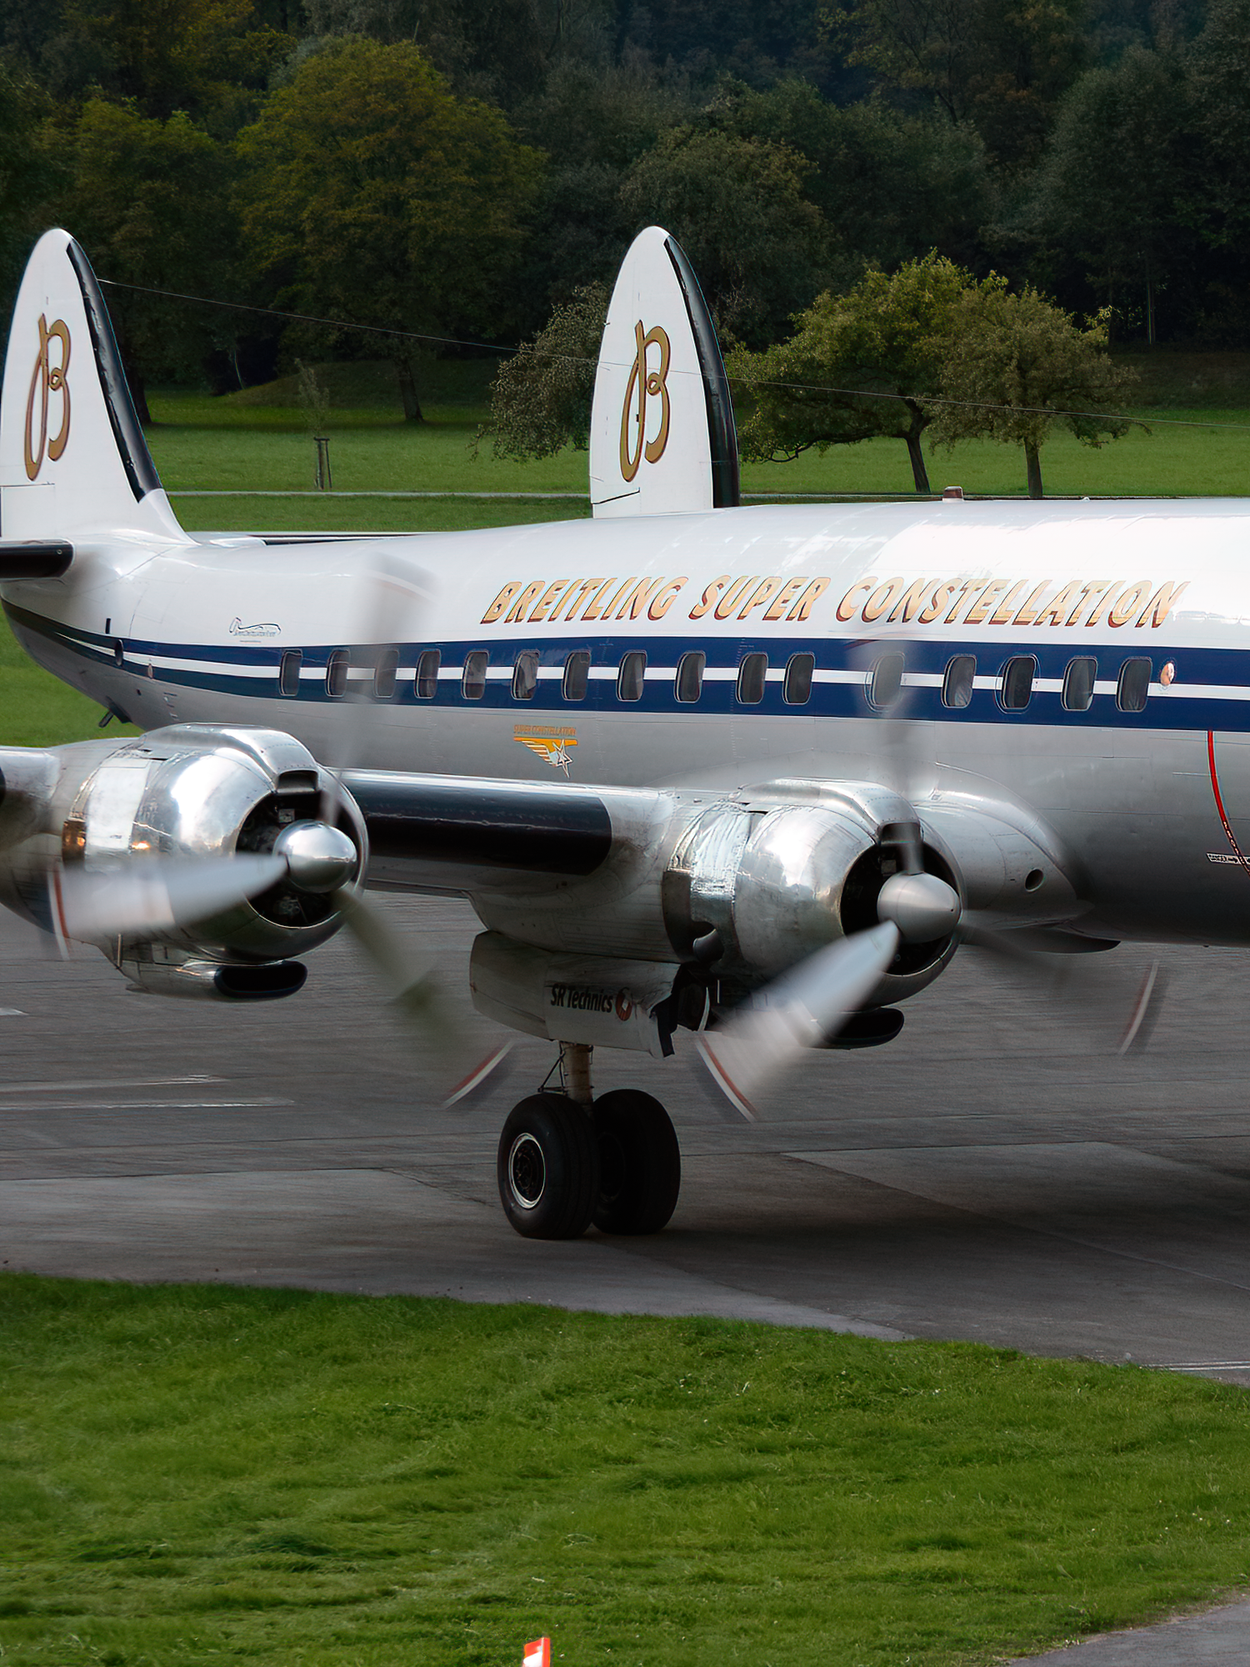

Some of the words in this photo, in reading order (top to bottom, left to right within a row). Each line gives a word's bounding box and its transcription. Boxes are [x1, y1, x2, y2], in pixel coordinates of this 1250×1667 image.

[480, 576, 689, 624] BREITLING
[688, 575, 831, 621] SUPER
[835, 576, 1191, 628] CONSTELLATION
[551, 984, 566, 1007] SR
[567, 986, 613, 1013] Technics
